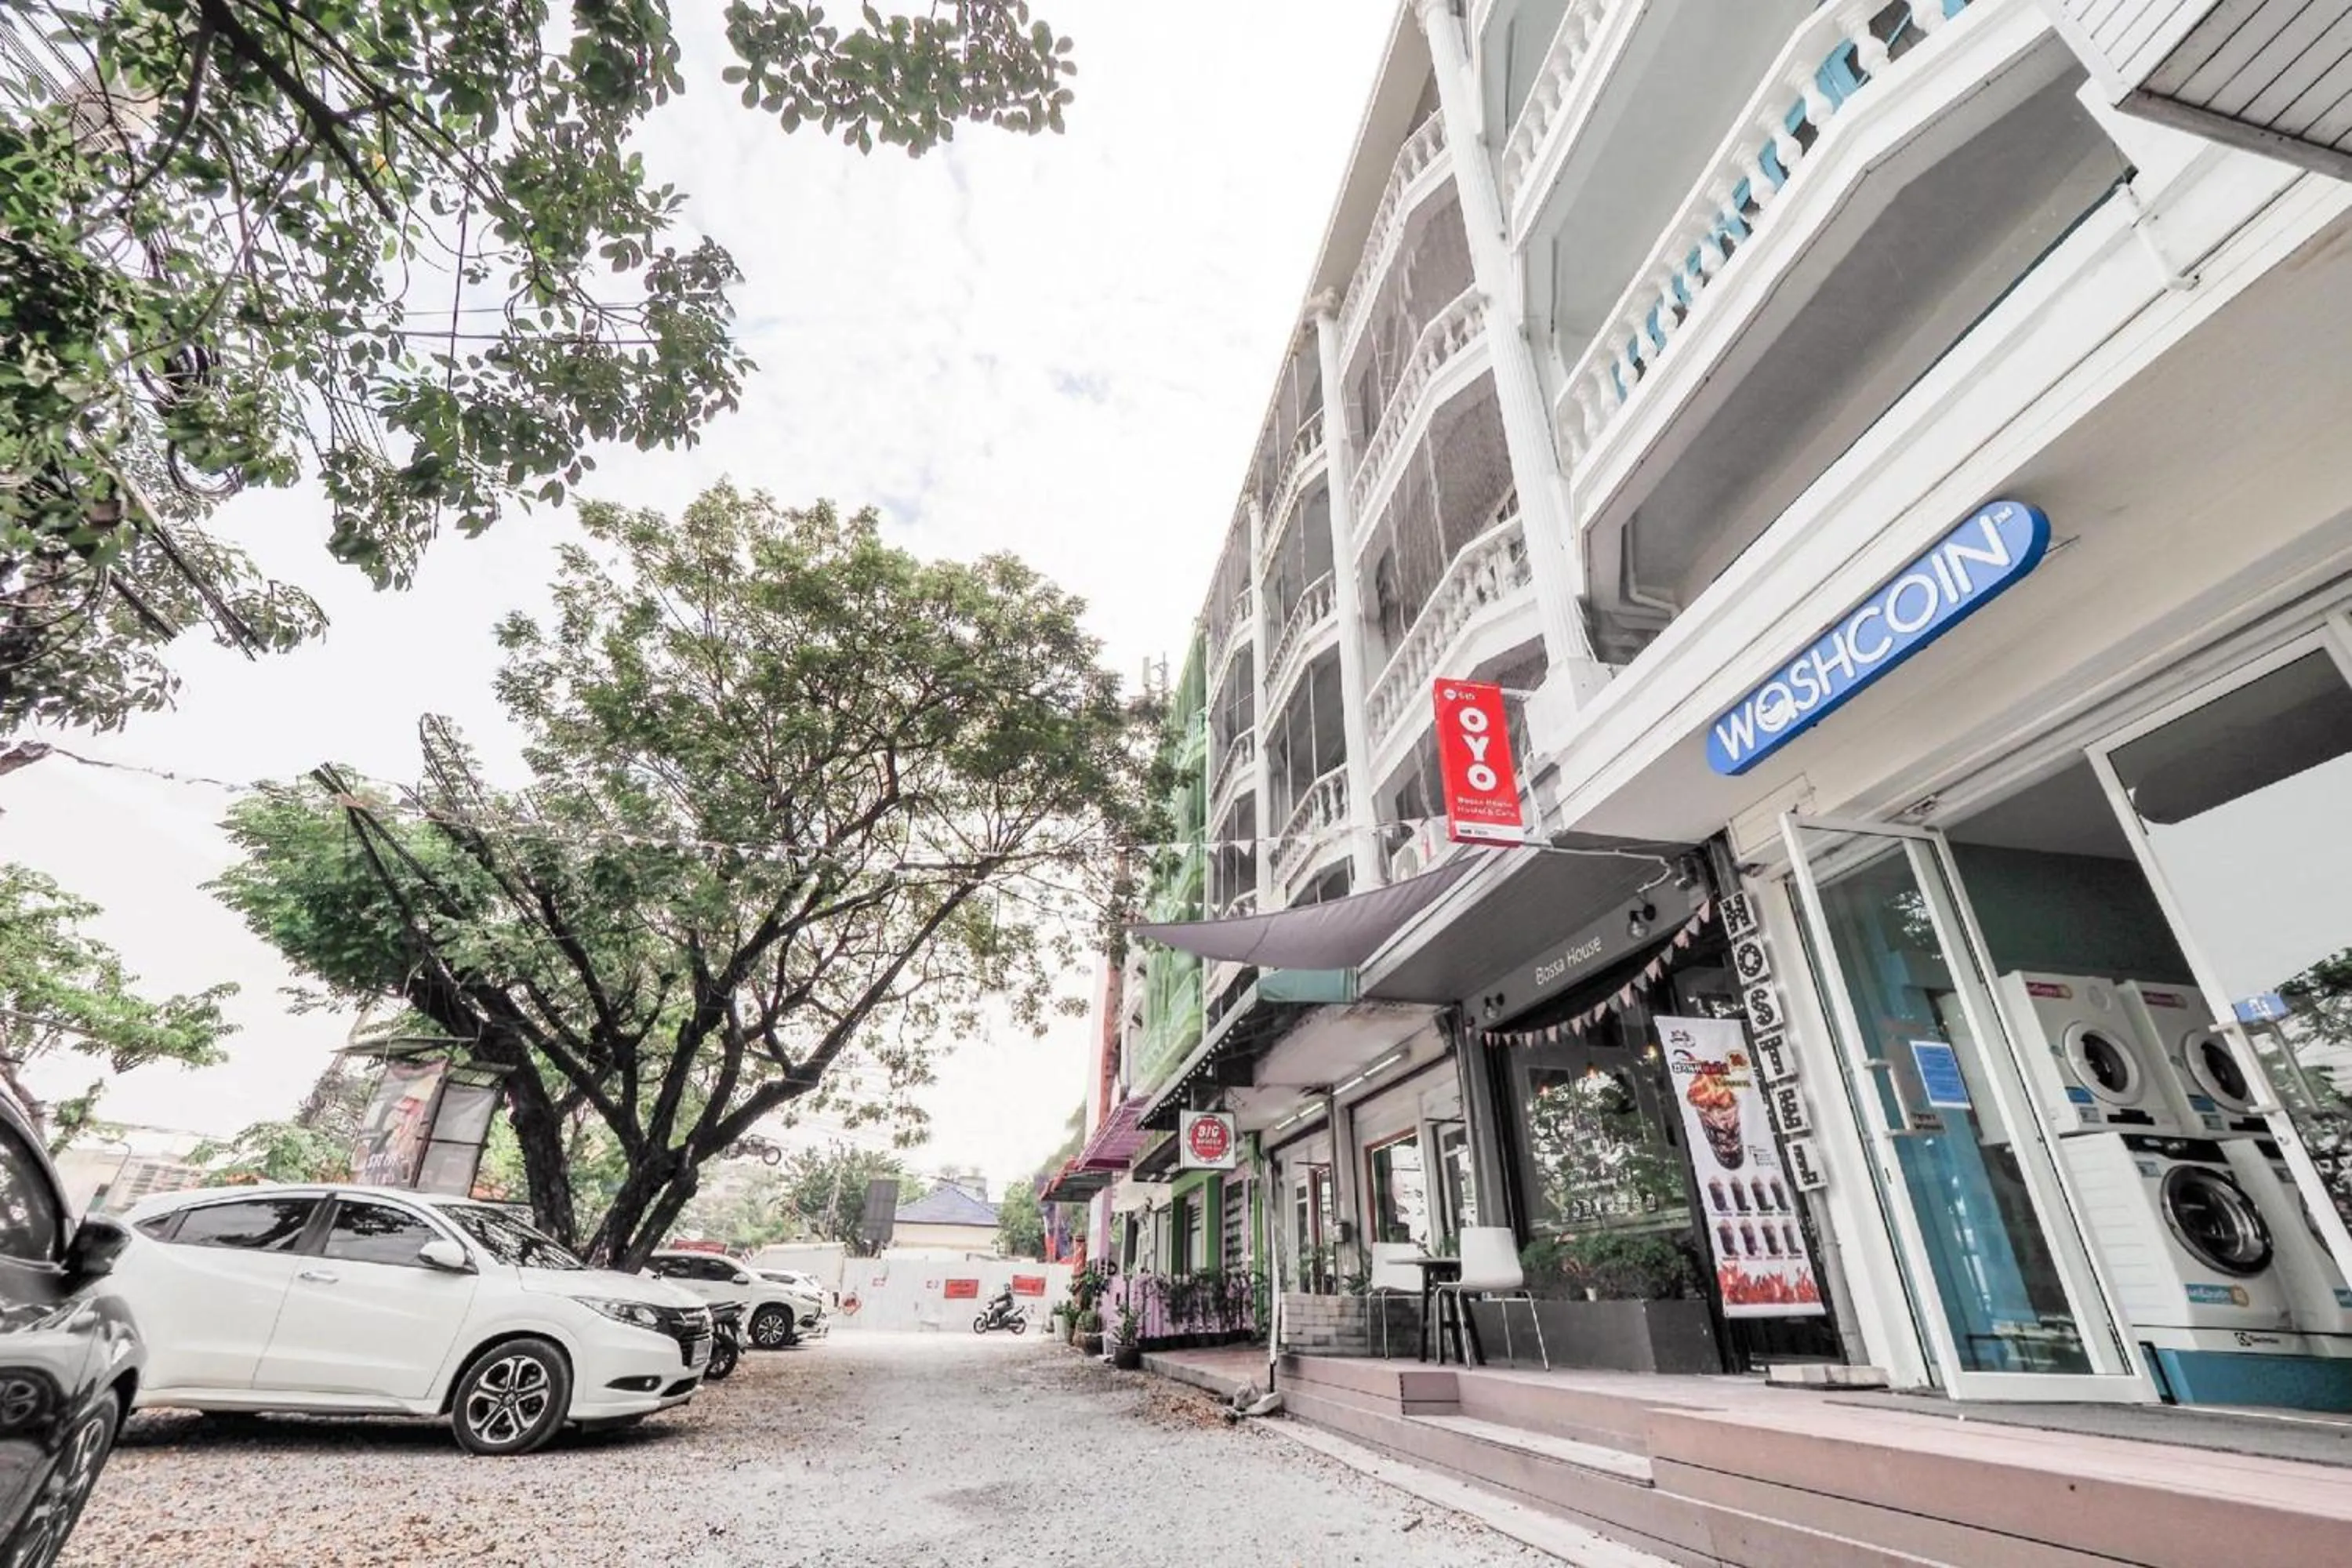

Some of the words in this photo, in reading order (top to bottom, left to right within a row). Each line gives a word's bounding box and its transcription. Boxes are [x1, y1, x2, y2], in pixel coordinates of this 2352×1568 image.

[1459, 706, 1497, 791] OYO
[1535, 956, 1565, 986] Bossa
[1566, 935, 1602, 966] House
[1722, 893, 1820, 1186] HOSTEL
